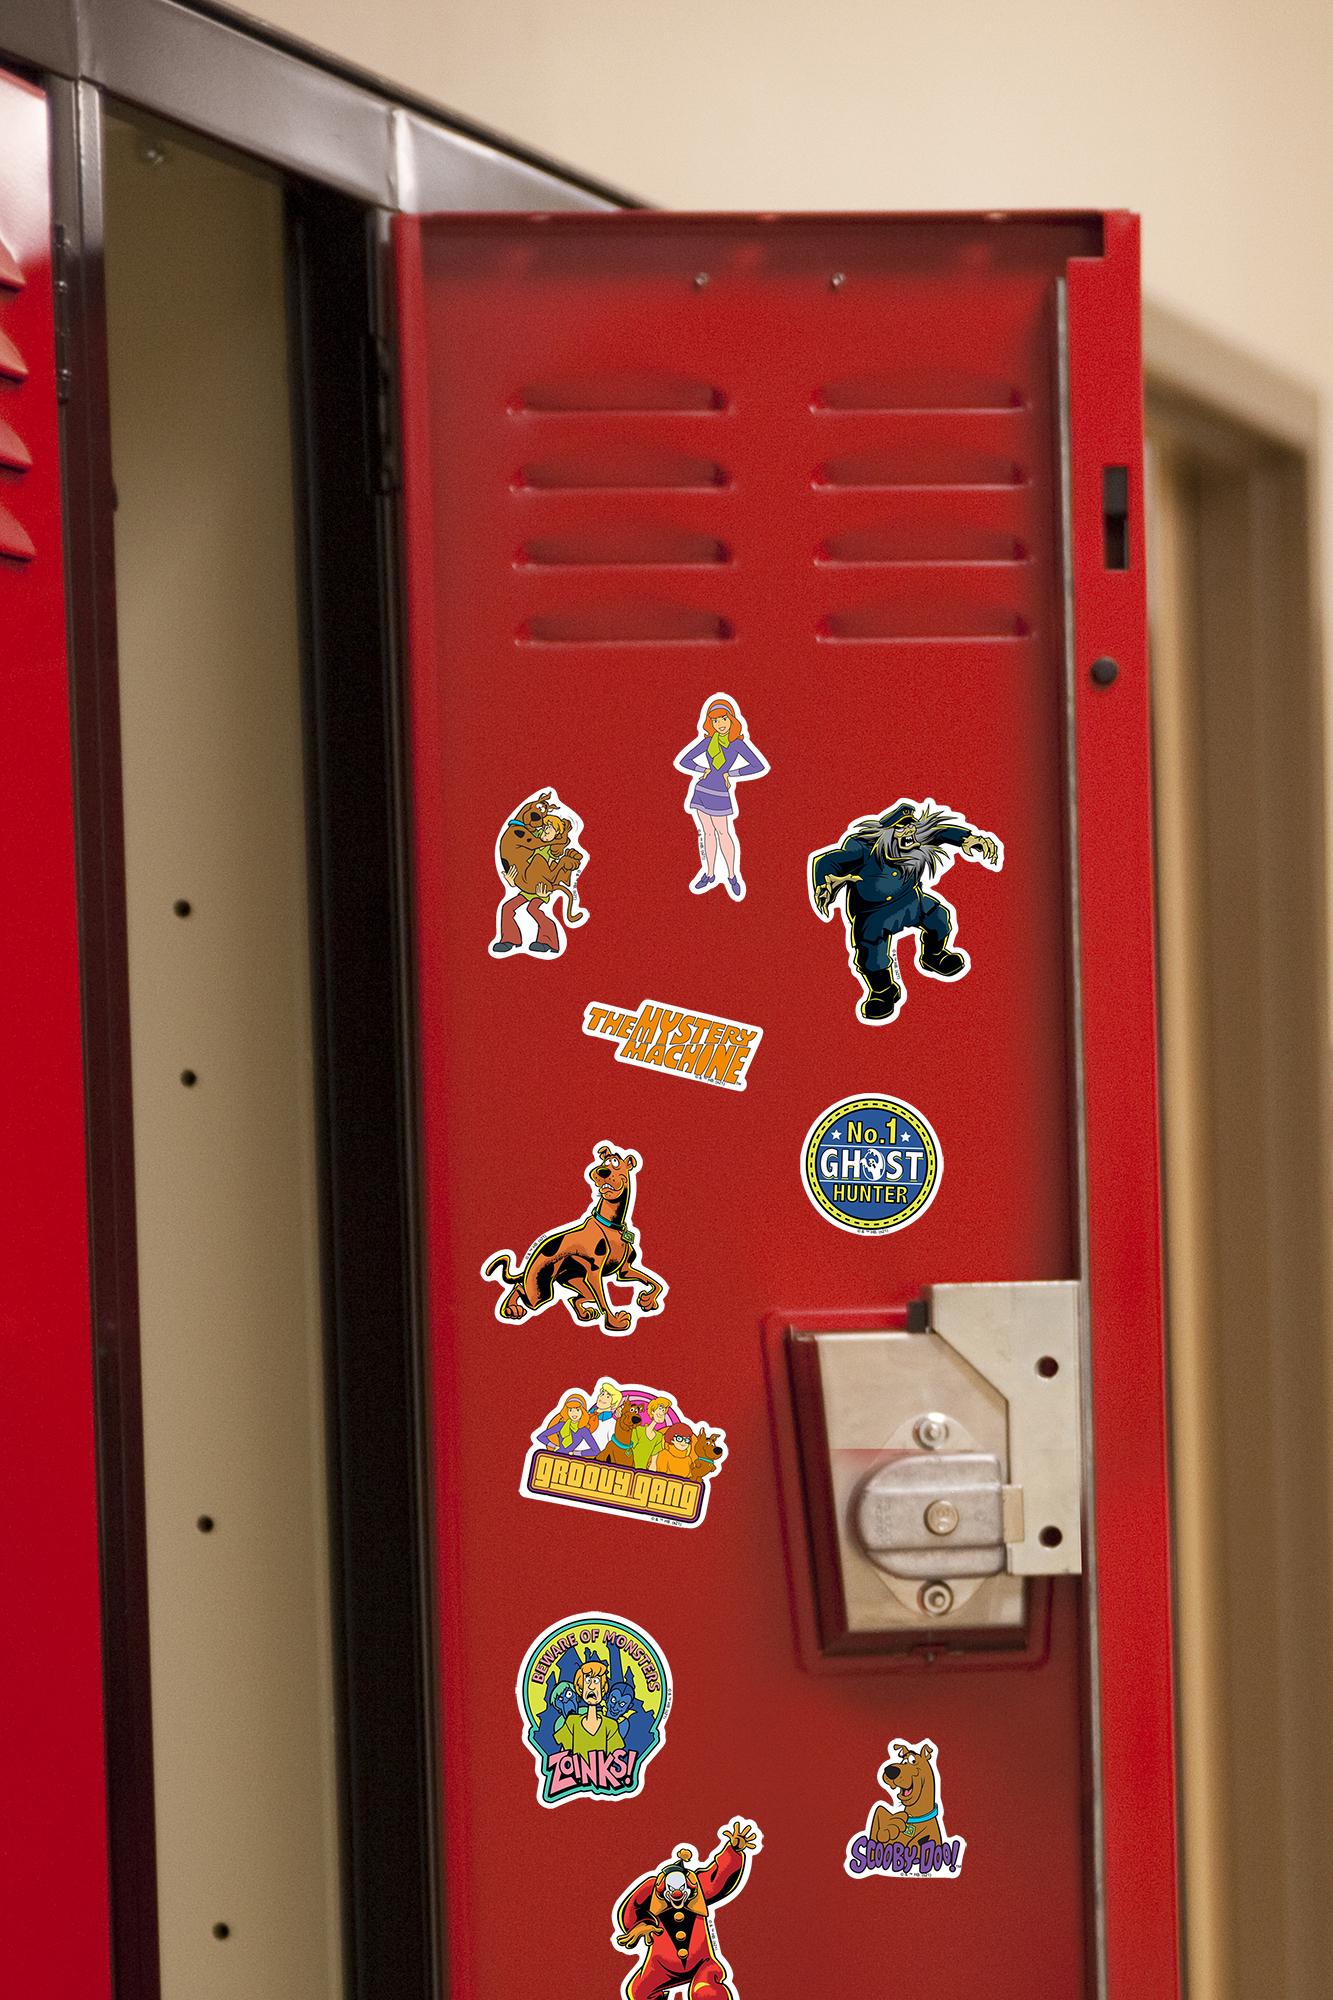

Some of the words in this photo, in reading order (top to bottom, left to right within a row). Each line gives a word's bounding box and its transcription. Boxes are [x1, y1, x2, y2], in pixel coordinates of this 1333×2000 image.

[588, 1007, 638, 1039] THE
[631, 1005, 757, 1046] MYSTERY
[620, 1040, 751, 1085] MACHINE
[847, 1117, 897, 1144] No.1
[820, 1148, 924, 1182] GHOST
[833, 1184, 908, 1204] HUNTER
[532, 1634, 578, 1684] BEWARE
[580, 1629, 600, 1644] OF
[603, 1630, 660, 1692] MONSTERS
[548, 1750, 638, 1795] ZOINKS!
[850, 1835, 960, 1873] SCOOBY-DOO!
